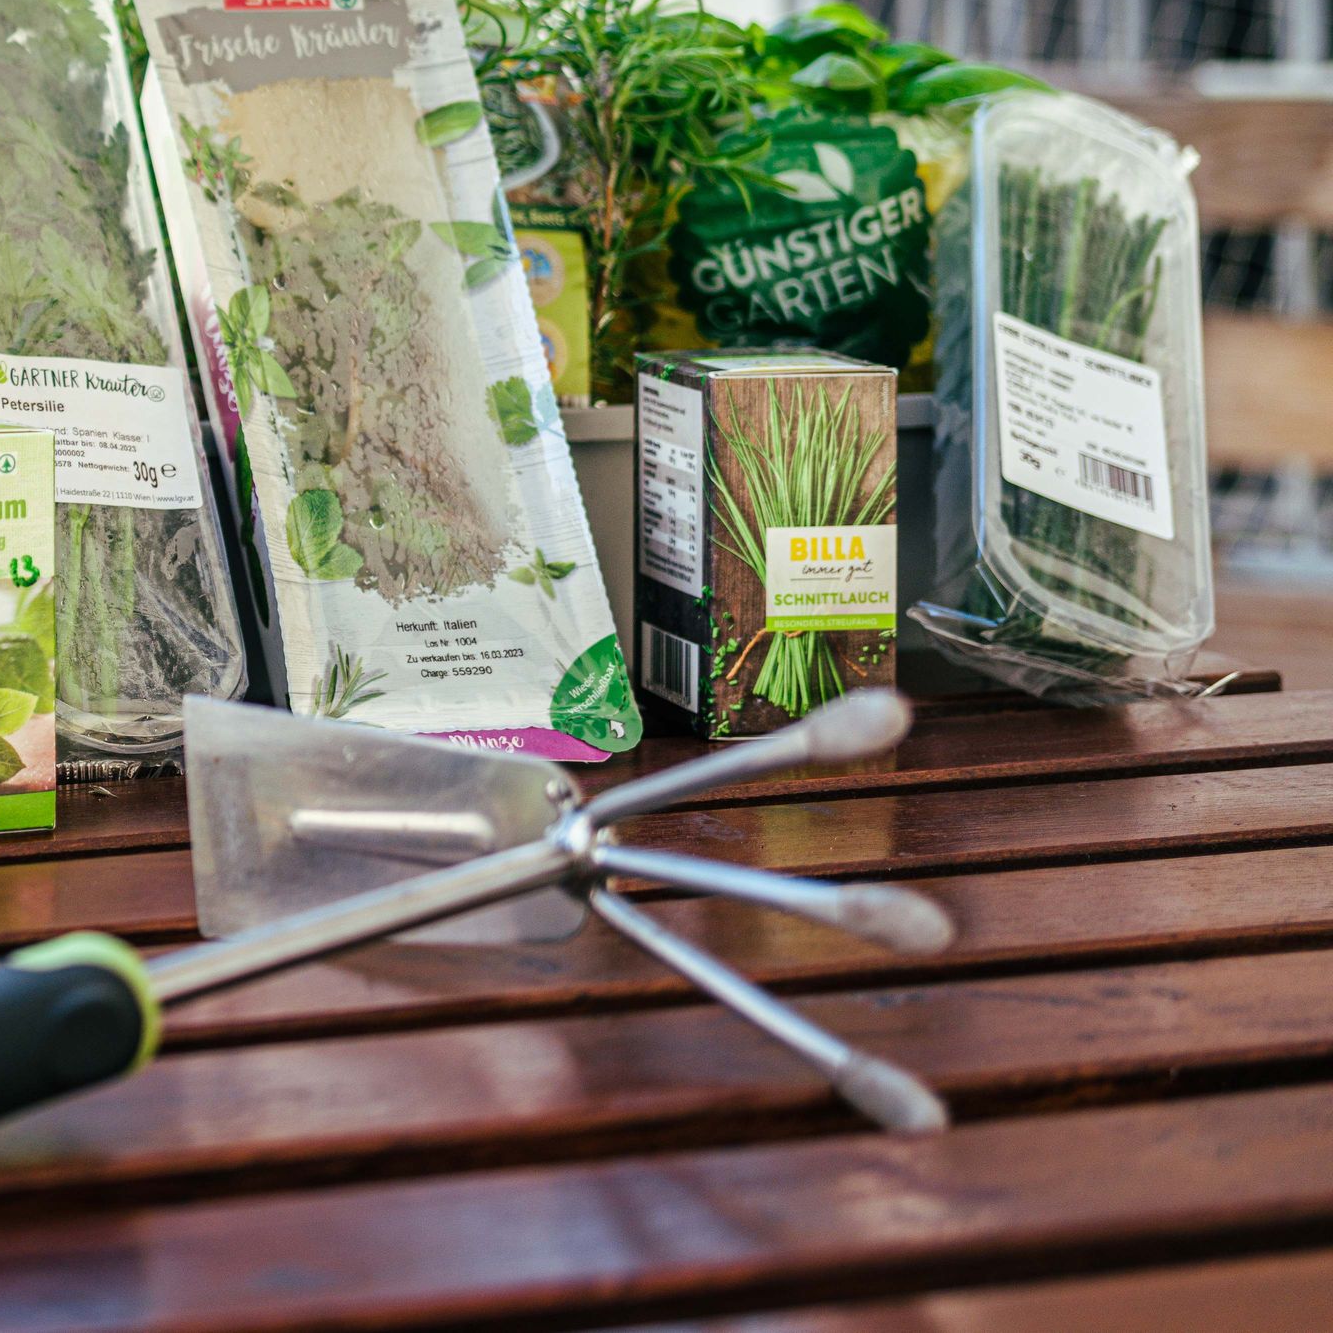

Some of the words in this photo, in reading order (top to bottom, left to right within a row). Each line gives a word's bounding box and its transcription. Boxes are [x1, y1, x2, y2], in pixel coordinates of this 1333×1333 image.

[178, 25, 281, 70] Frische
[289, 17, 401, 59] Kräuter
[692, 186, 924, 294] GÜNSTIGER
[705, 244, 901, 335] GARTEN
[1, 397, 66, 413] Petersilie
[72, 426, 109, 439] Spanien
[132, 460, 159, 489] 30g
[789, 535, 866, 562] BILLA
[845, 559, 874, 583] gut
[773, 590, 889, 606] SCHNITTLAUCH
[443, 619, 478, 631] Italien
[454, 637, 478, 647] 1004
[406, 654, 419, 664] Zu
[420, 652, 461, 663] verkaufen
[480, 648, 524, 660] 16.03.2023
[452, 666, 493, 677] 559290
